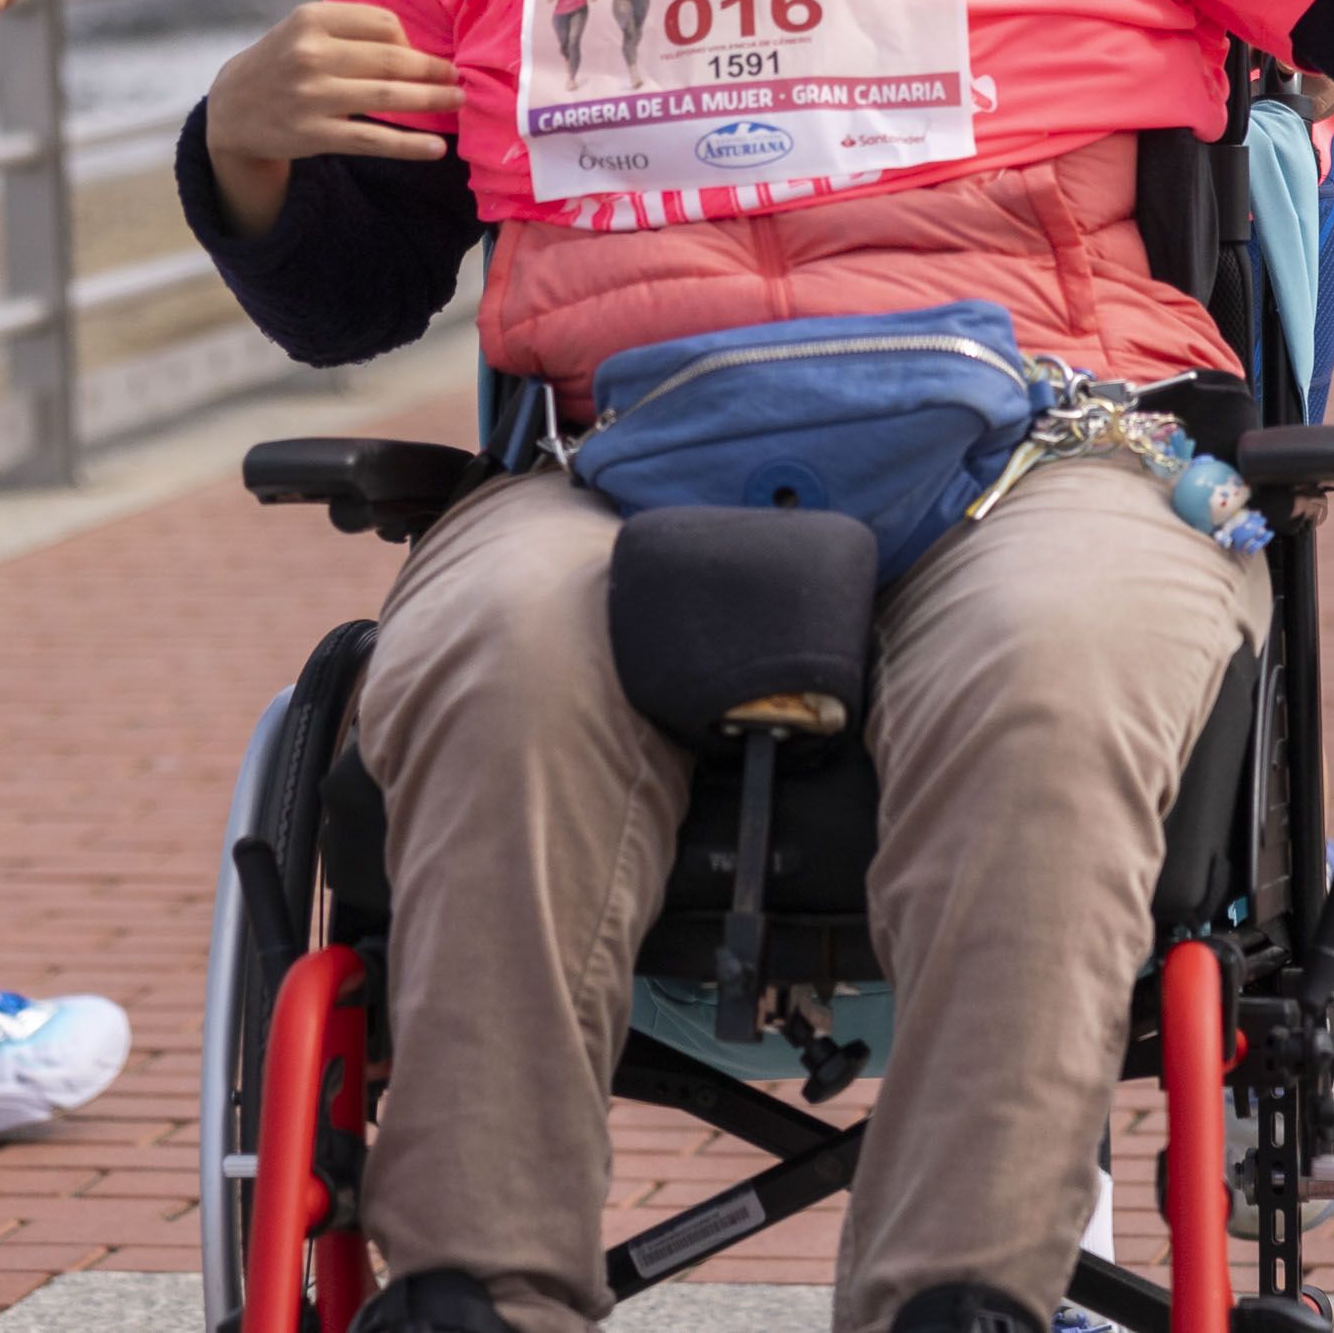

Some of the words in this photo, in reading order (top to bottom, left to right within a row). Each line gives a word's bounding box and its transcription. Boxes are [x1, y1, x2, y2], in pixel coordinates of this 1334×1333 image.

[708, 50, 779, 79] 1591
[538, 100, 631, 132] CARRERA
[636, 97, 663, 118] DE
[669, 94, 696, 115] LA
[701, 87, 773, 112] MUJER
[792, 84, 848, 105] GRAN
[854, 80, 946, 105] CANARIA
[704, 140, 786, 160] ASTURIANA
[858, 134, 927, 147] Santander
[578, 152, 650, 171] OYSHO
